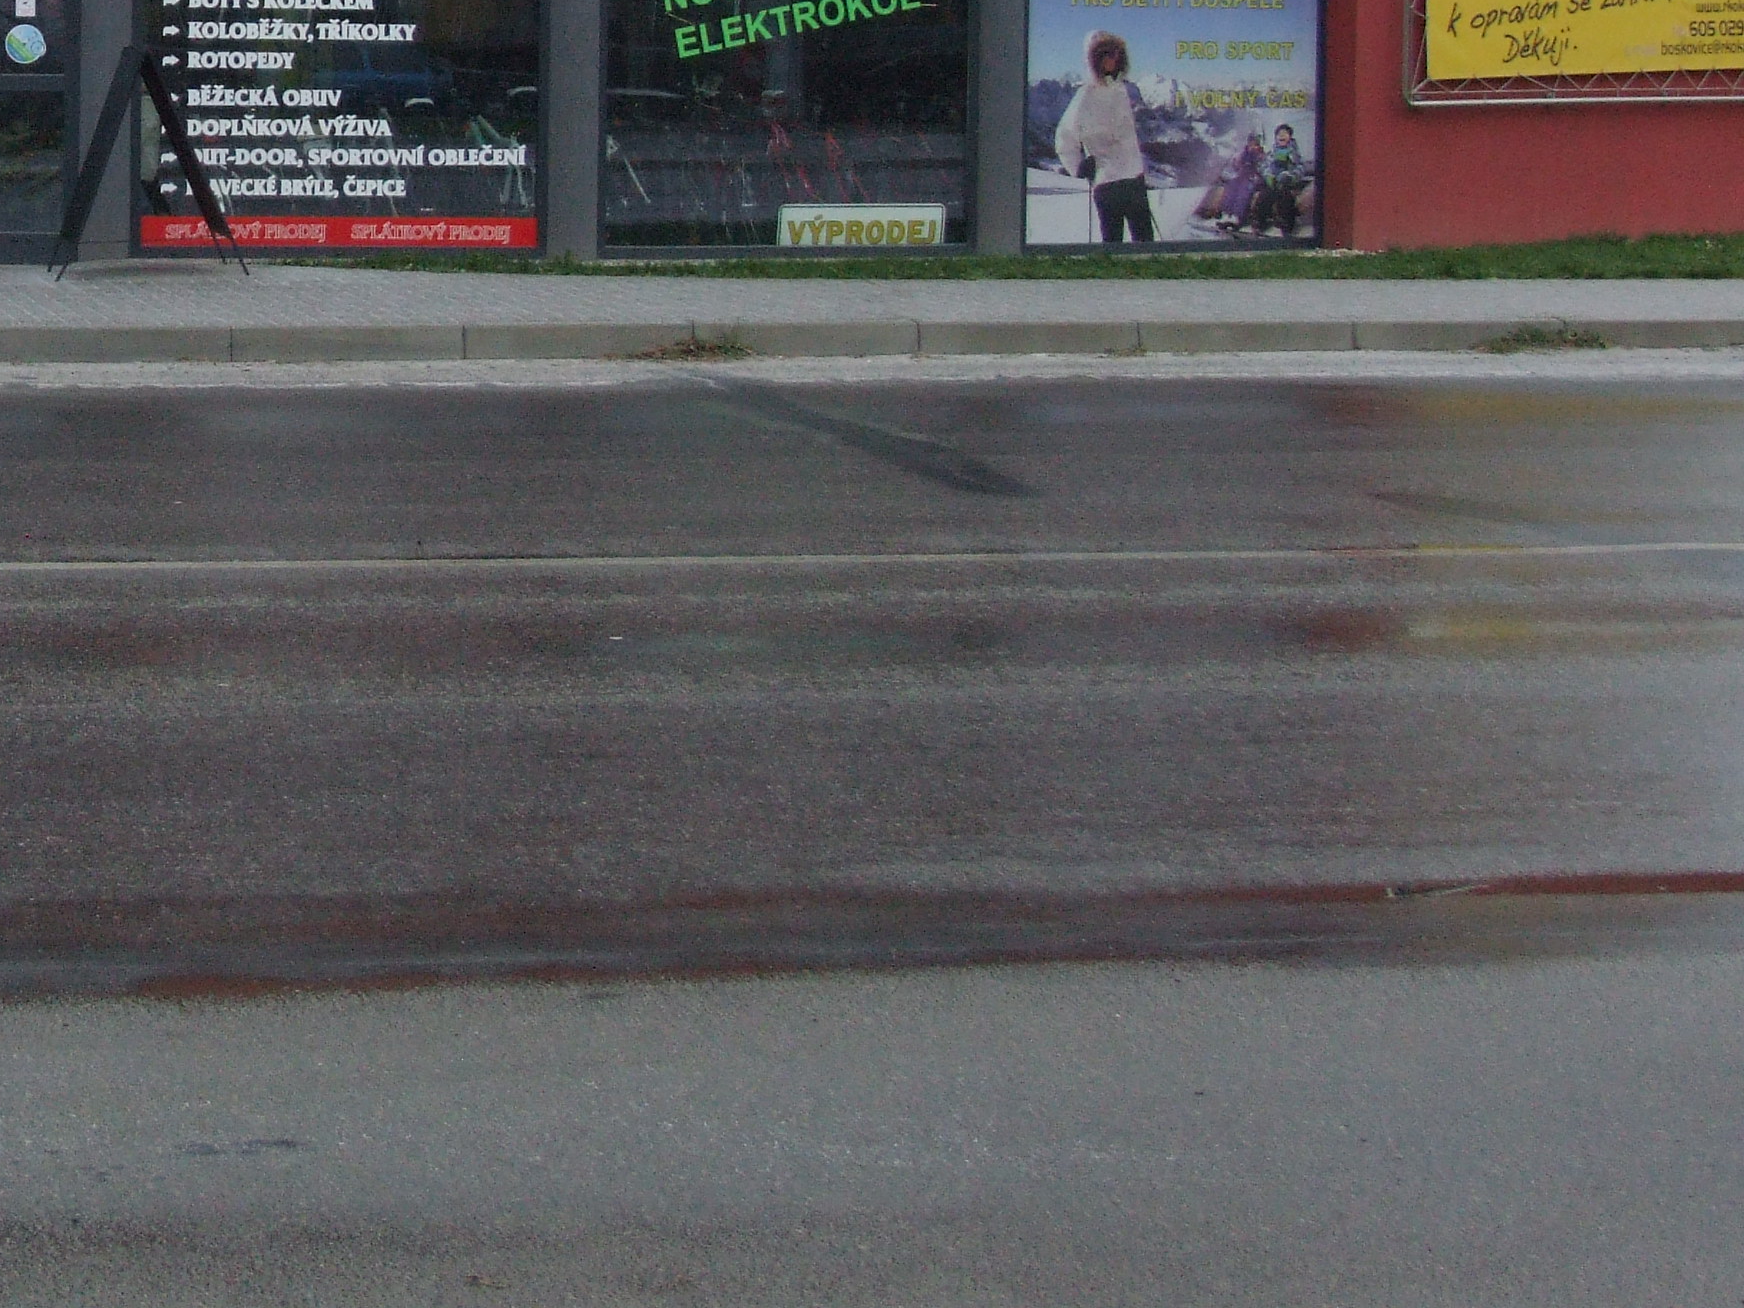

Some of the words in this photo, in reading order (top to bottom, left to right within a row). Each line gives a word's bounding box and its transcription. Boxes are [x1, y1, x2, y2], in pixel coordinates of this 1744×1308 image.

[188, 18, 314, 43] KOLOBĚŽKY,
[316, 19, 416, 41] TŘÍKOLKY
[1689, 20, 1716, 37] 605
[187, 51, 295, 69] ROTOPEDY
[1175, 41, 1218, 60] PRO
[1224, 41, 1294, 60] SPORT
[187, 84, 279, 107] BĚŽECKÁ
[282, 89, 342, 107] OBUV
[1192, 85, 1259, 109] VOLNÝ
[1265, 88, 1307, 109] ČAS
[187, 114, 314, 136] DOPLŇKOVÁ
[318, 114, 393, 137] VÝŽIVA
[196, 147, 303, 168] UT-DOOR,
[307, 145, 425, 166] SPORTOVNÍ
[427, 144, 526, 166] OBLEČENÍ
[186, 174, 277, 196] AVECKÉ
[342, 175, 407, 196] ČEPICE
[264, 224, 327, 243] PRODEJ
[351, 221, 446, 241] SPLÁTKOVÝ
[449, 224, 512, 244] PRODEJ
[787, 214, 937, 245] VÝPRODEJ
